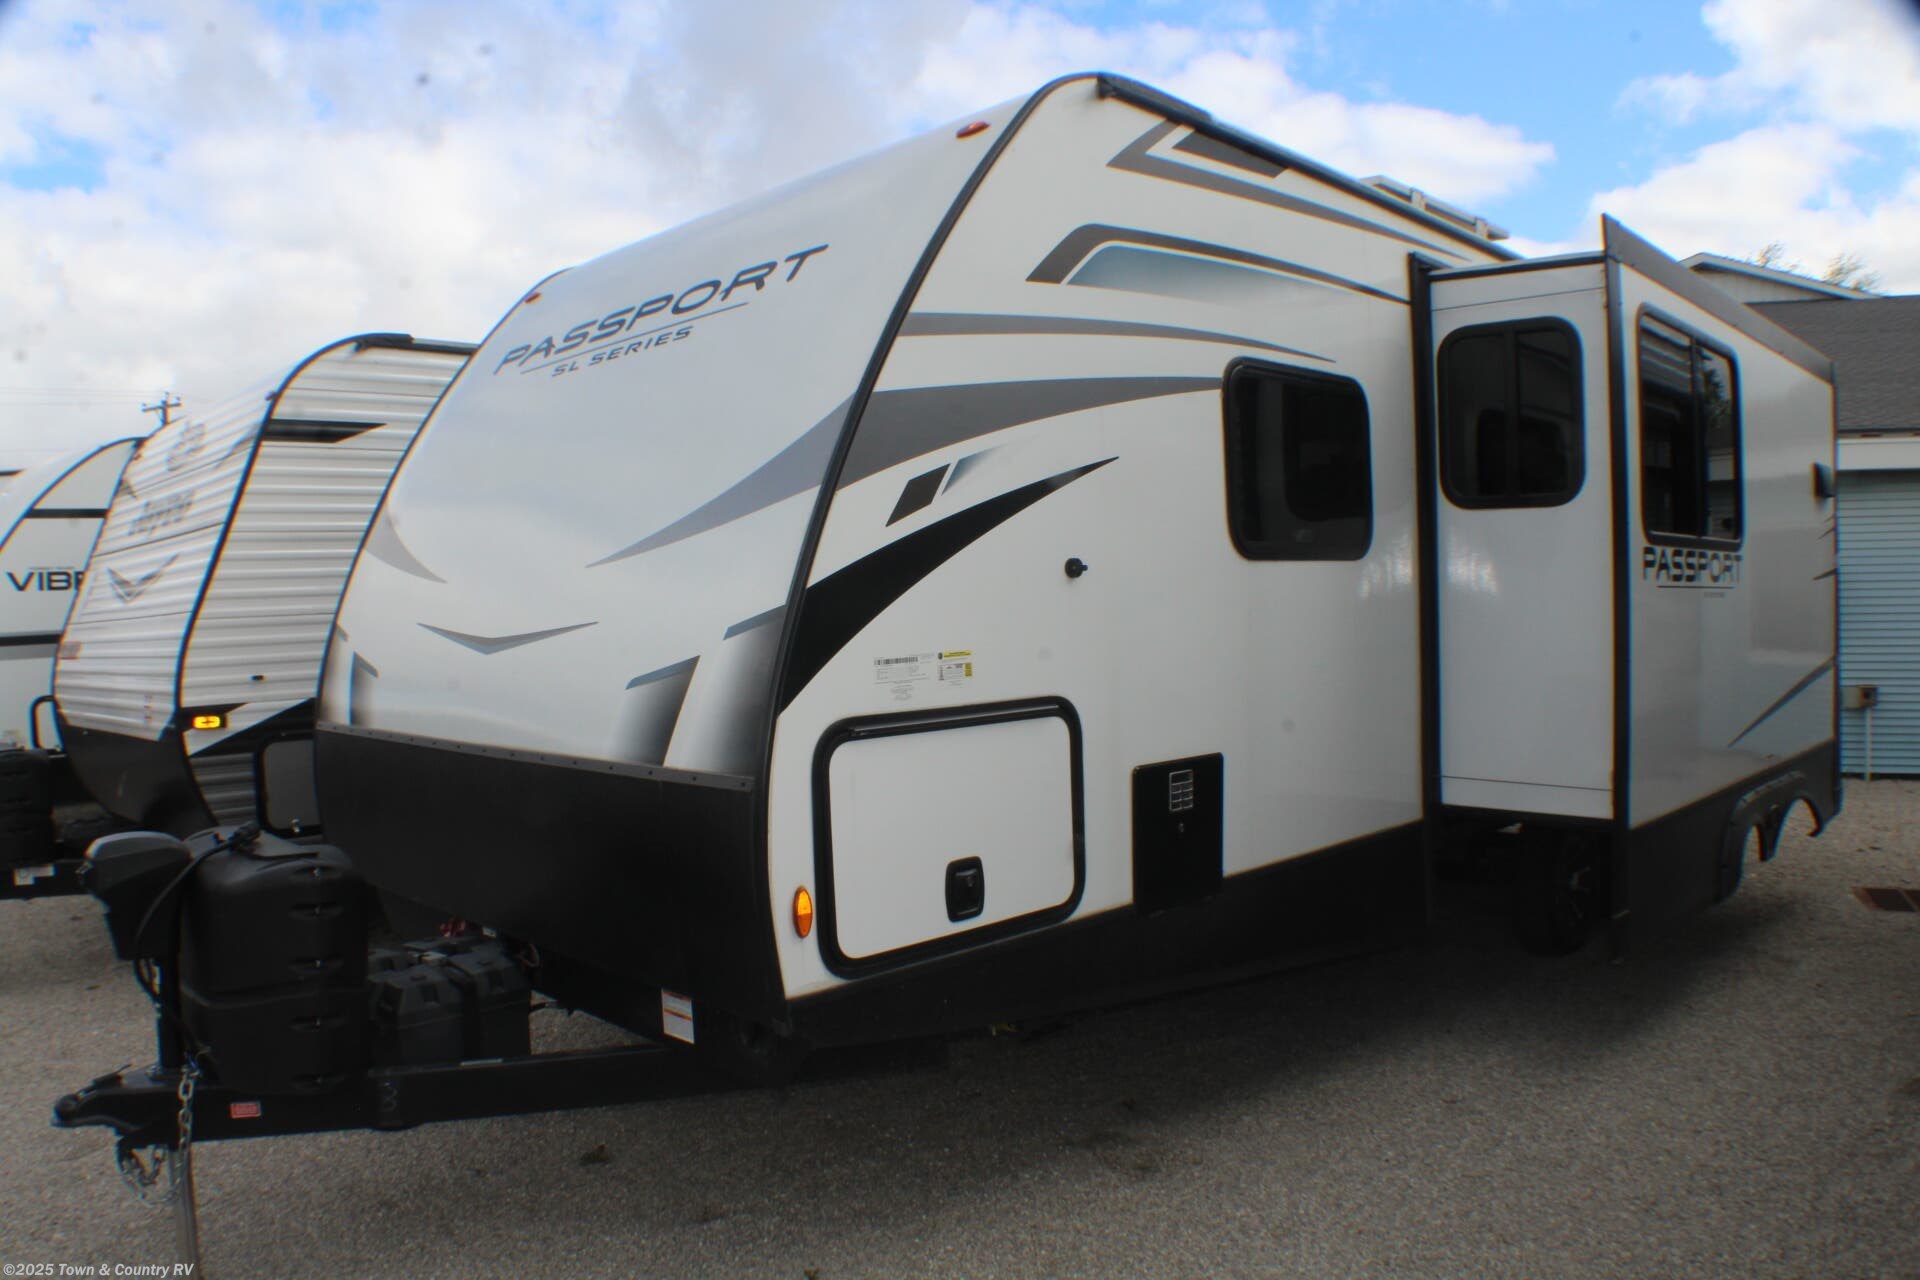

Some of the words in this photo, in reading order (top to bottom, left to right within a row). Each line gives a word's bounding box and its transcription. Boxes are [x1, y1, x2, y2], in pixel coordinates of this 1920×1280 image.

[494, 244, 829, 374] PASSPORT
[552, 362, 578, 376] SL
[590, 326, 693, 366] SERIES
[1643, 547, 1742, 583] PASSPORT
